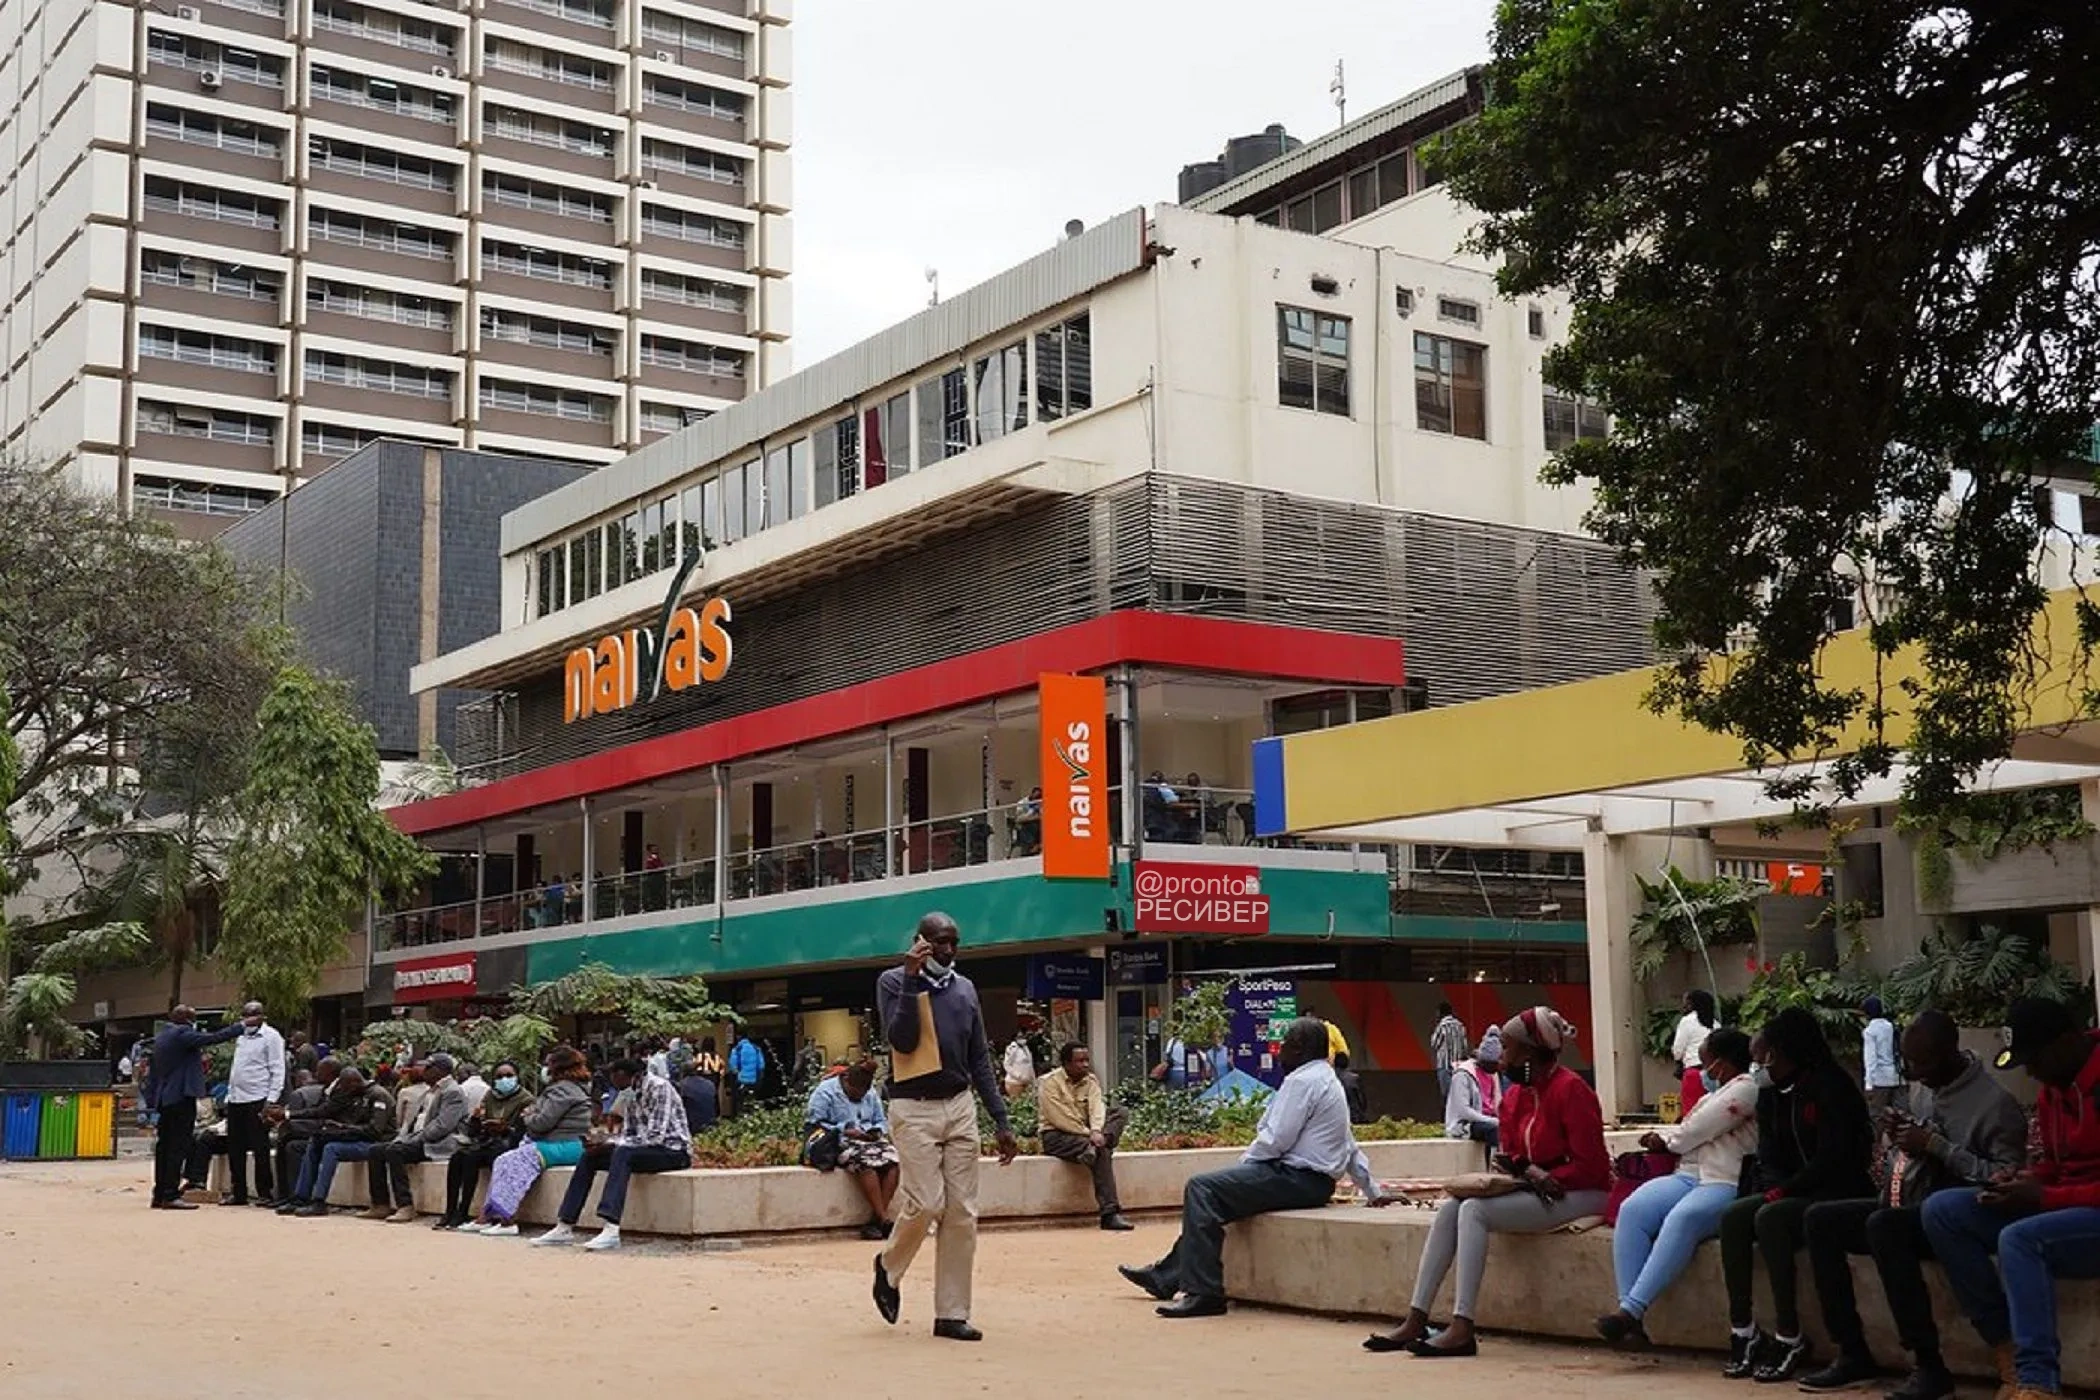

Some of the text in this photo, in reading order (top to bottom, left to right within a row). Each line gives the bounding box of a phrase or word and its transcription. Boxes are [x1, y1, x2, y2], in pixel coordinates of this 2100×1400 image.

[1053, 721, 1091, 838] naivas
[1135, 870, 1246, 899] @pronto
[1136, 898, 1269, 923] РЕСИВЕР
